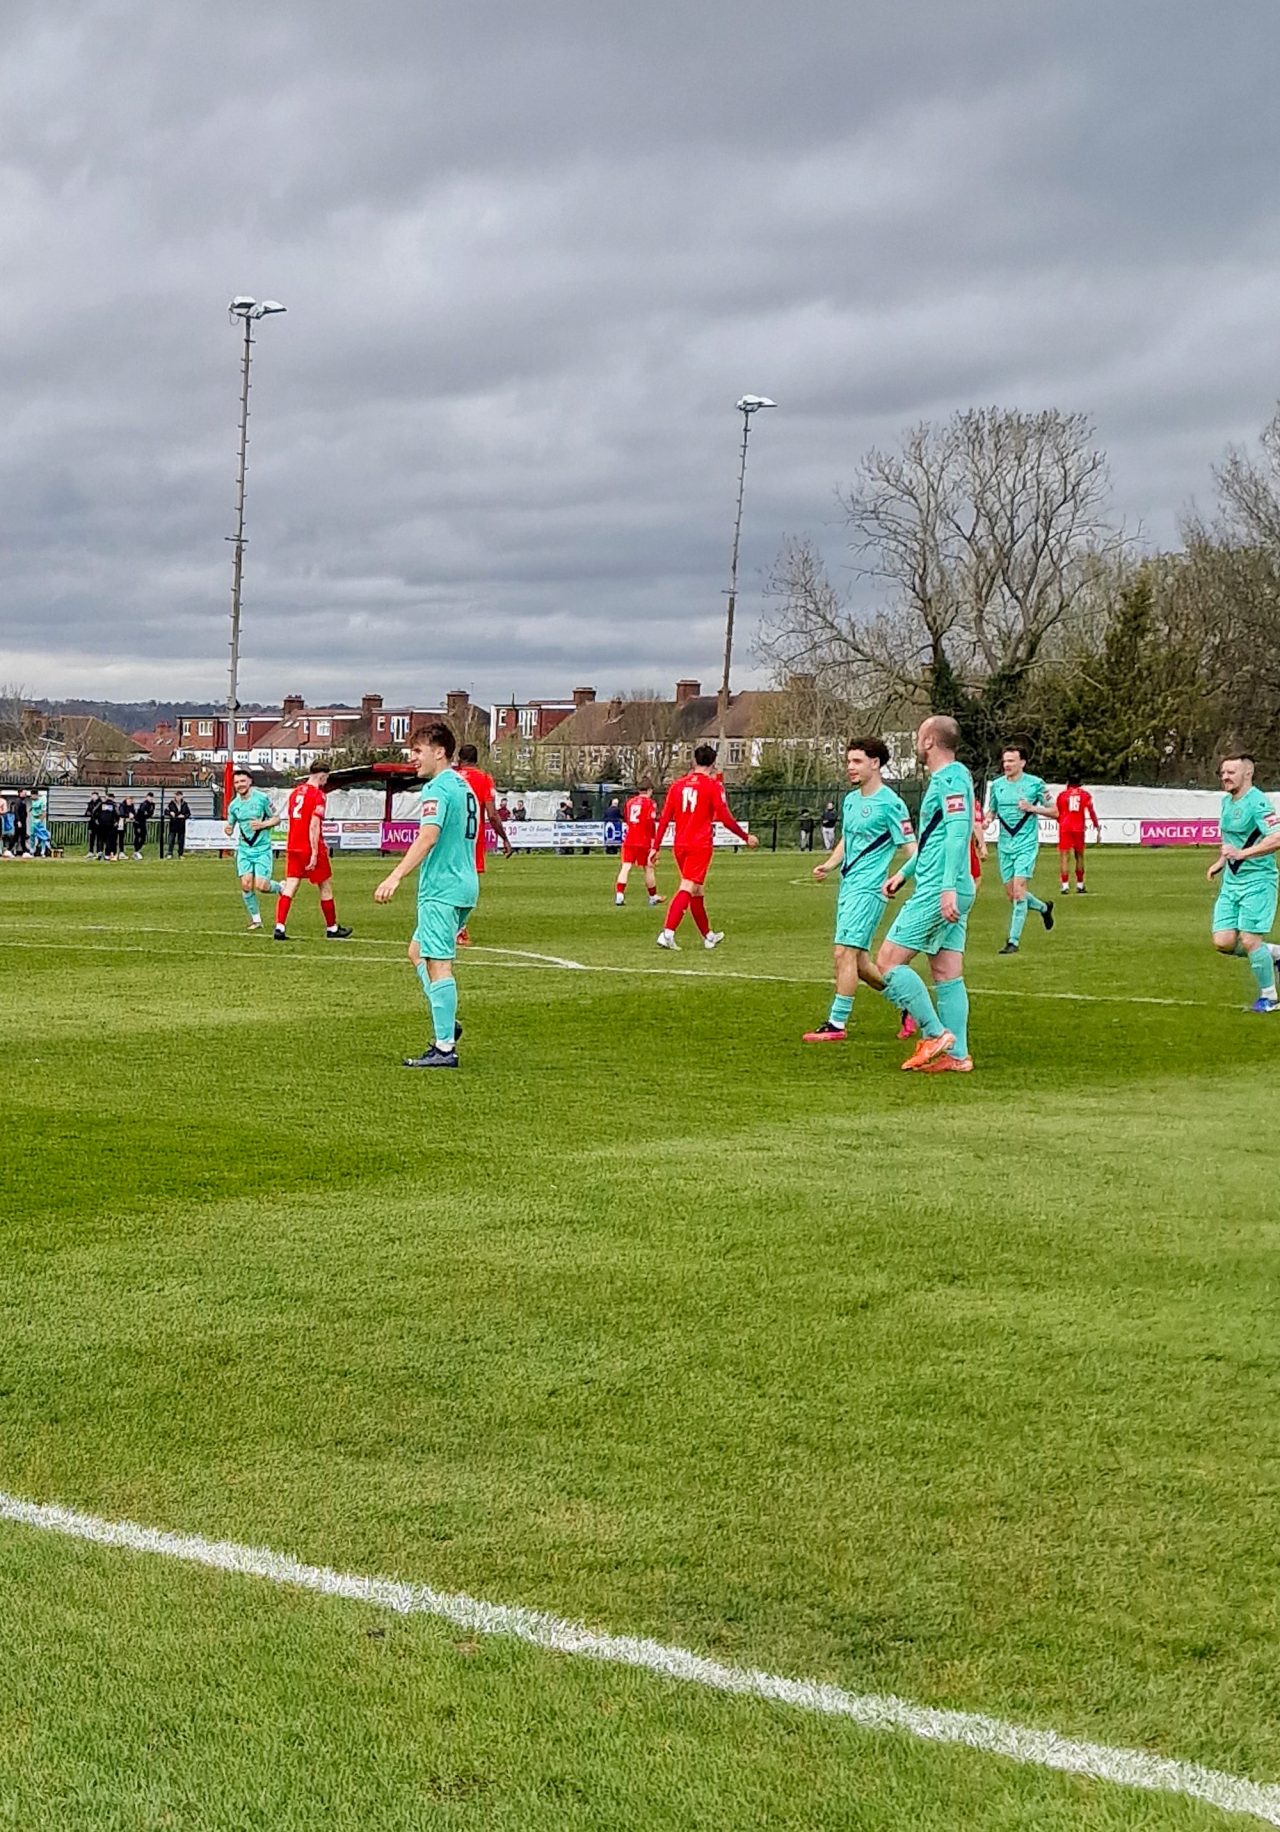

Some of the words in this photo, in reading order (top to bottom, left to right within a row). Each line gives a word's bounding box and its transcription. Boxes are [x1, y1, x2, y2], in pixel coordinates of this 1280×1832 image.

[292, 794, 305, 818] 2
[682, 787, 698, 813] 14
[1068, 795, 1080, 812] 16
[464, 792, 477, 839] 8
[629, 804, 642, 822] 12
[382, 829, 420, 843] LANGLE
[1140, 826, 1199, 838] LANGLEY
